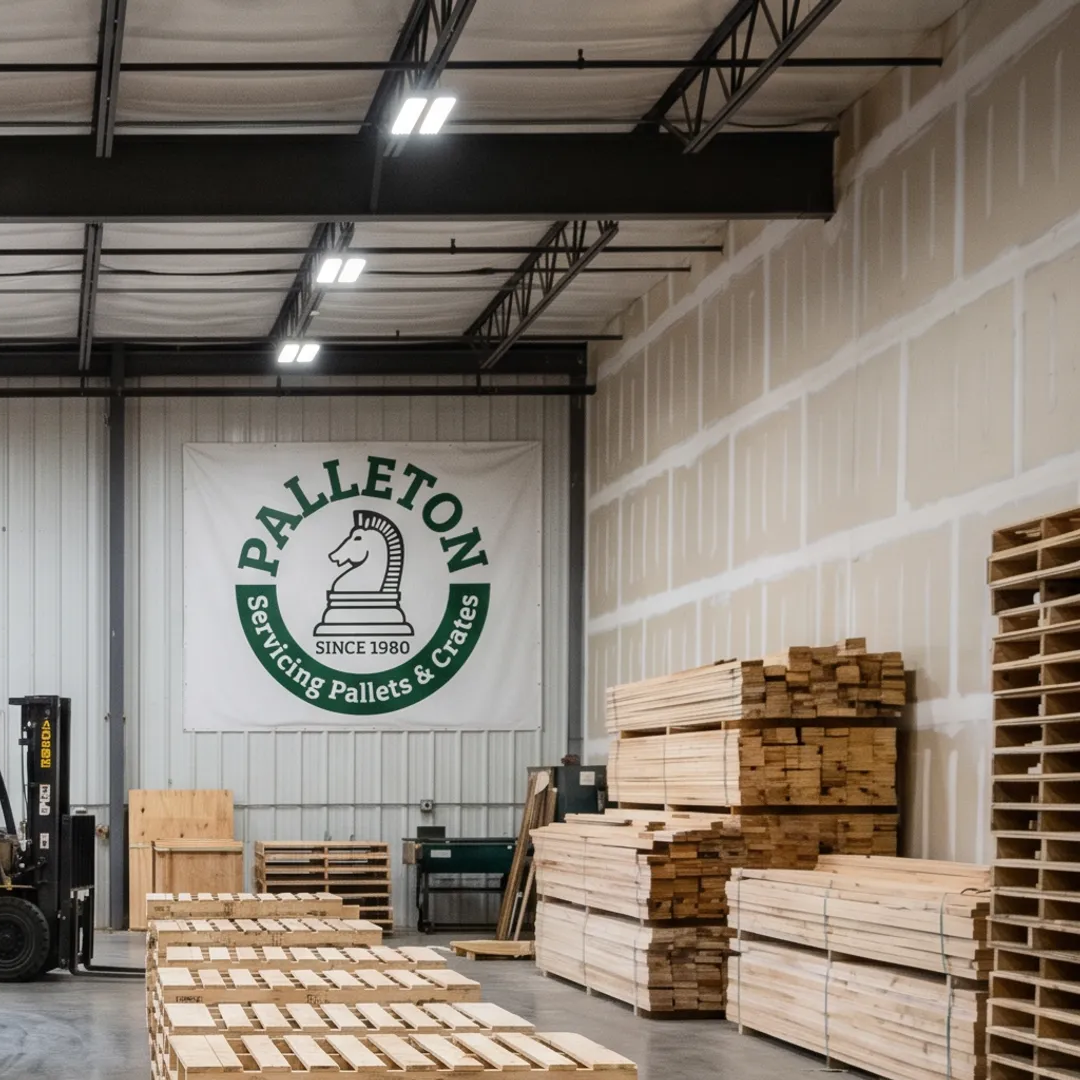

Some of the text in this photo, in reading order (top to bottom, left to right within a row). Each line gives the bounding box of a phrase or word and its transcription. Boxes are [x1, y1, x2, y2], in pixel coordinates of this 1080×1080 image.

[237, 455, 489, 577] PALLETON
[247, 594, 479, 703] Servicing Pallets & Crates
[315, 641, 410, 655] SINCE 1980
